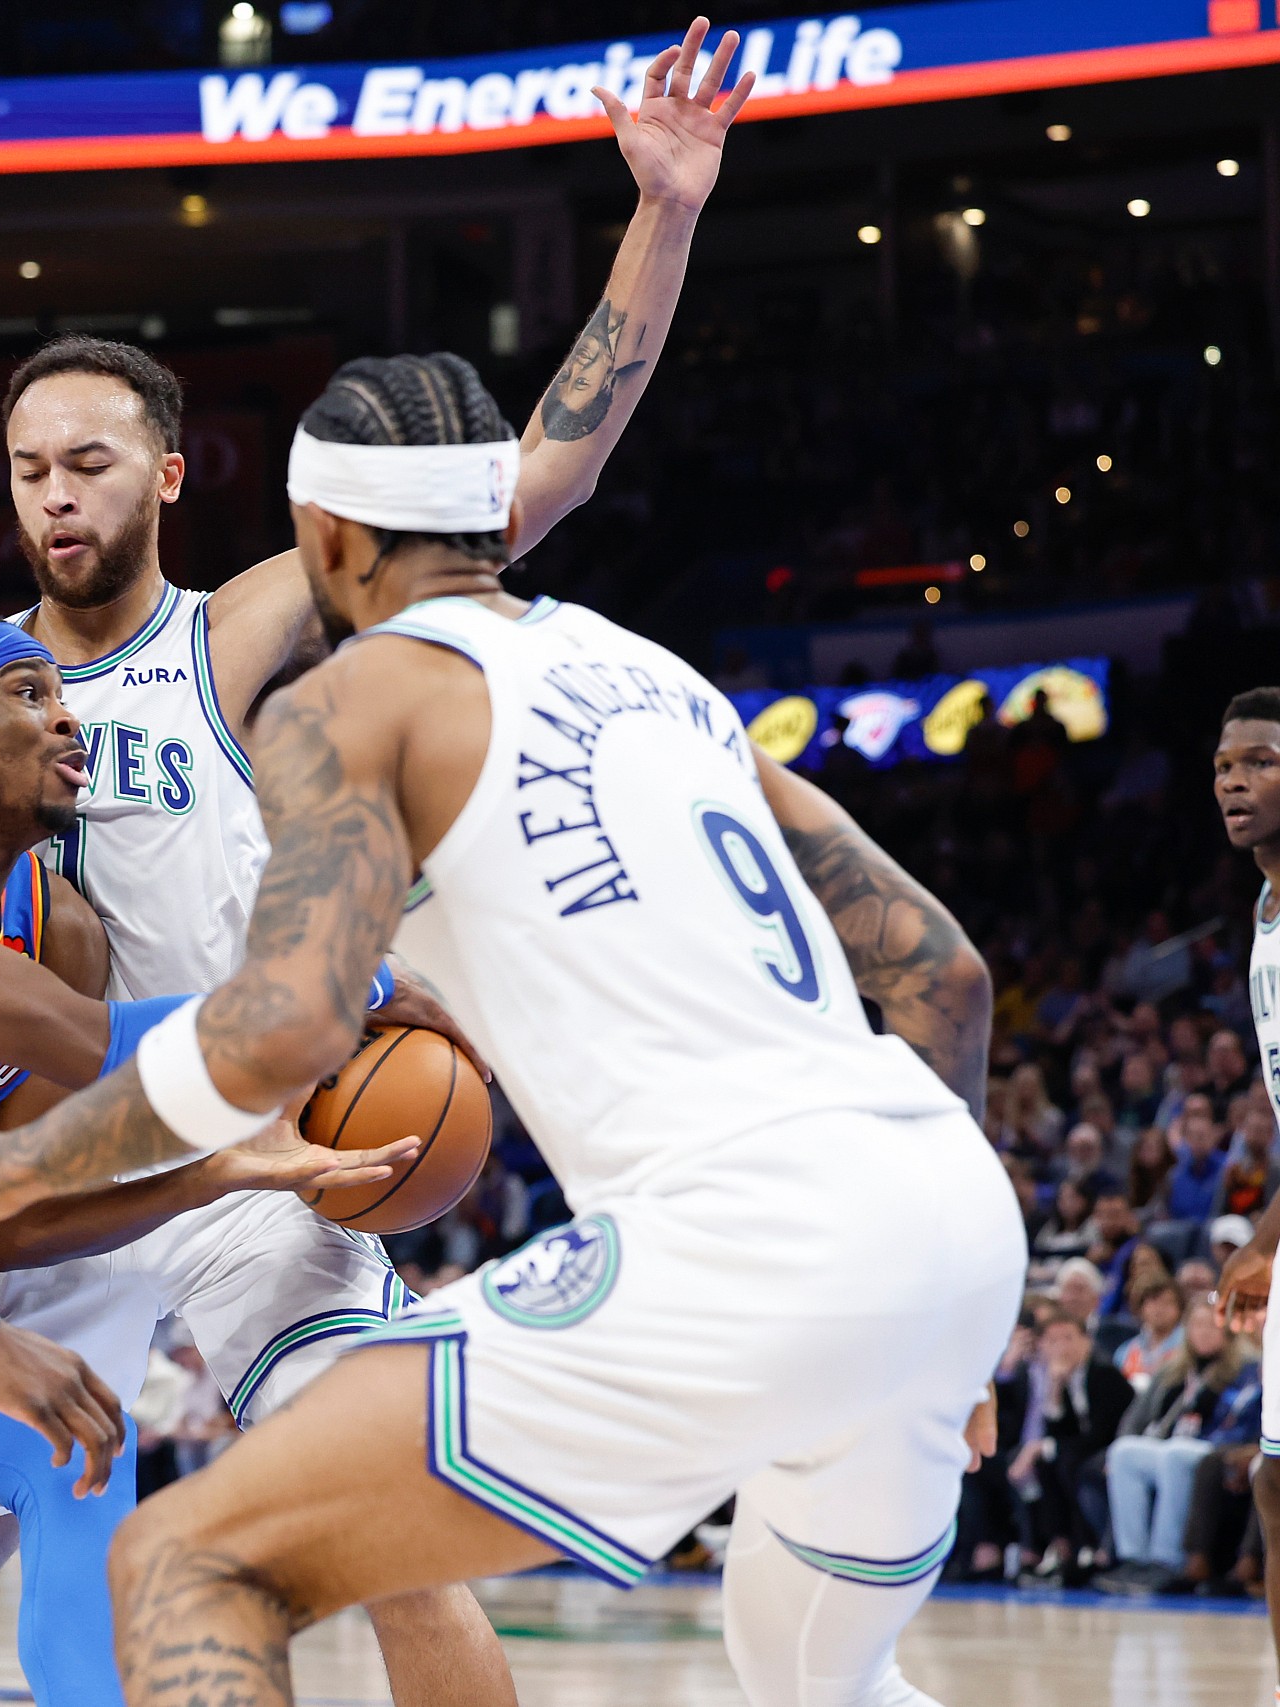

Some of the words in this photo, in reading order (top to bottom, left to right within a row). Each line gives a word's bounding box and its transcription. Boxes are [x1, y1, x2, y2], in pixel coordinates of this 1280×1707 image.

[198, 71, 339, 143] We
[737, 15, 903, 99] Life
[75, 719, 196, 816] VES
[691, 799, 830, 1013] 9
